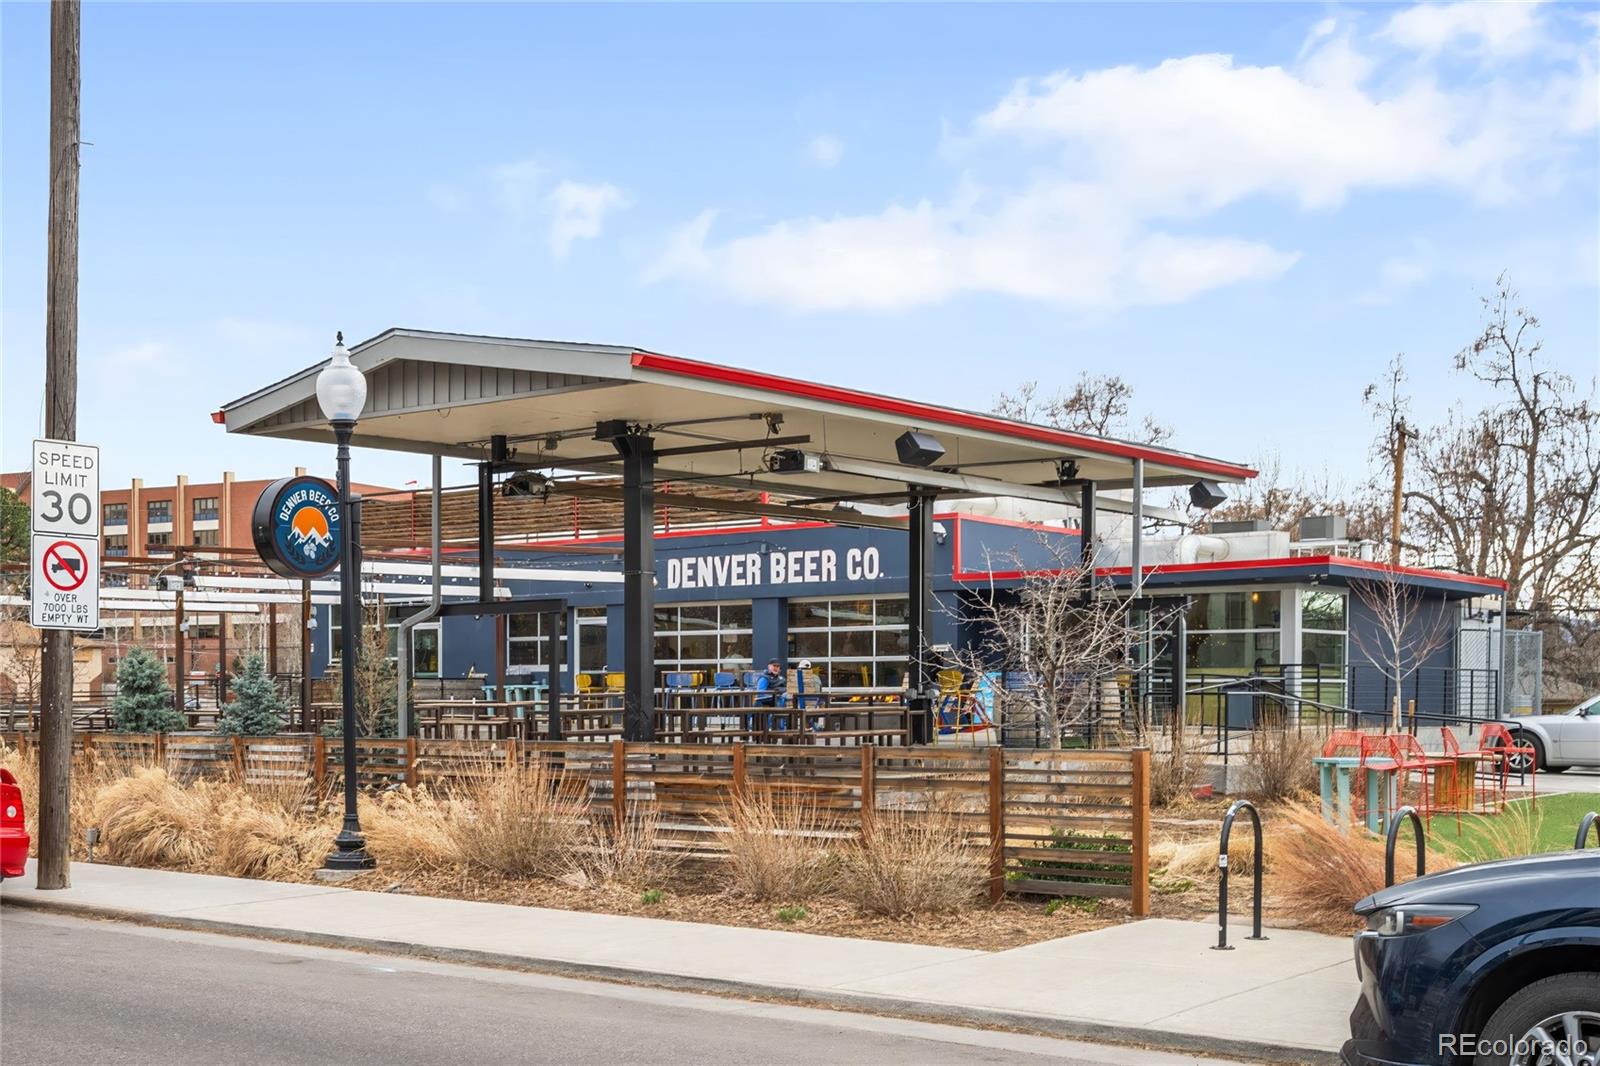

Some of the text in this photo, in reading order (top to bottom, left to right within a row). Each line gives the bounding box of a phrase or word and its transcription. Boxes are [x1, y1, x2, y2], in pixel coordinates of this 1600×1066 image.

[39, 451, 94, 470] SPEED
[45, 471, 88, 488] LIMIT
[40, 490, 92, 525] 30
[279, 489, 308, 521] DENVER
[327, 507, 340, 522] CO
[667, 546, 884, 589] DENVER BEER CO.
[54, 592, 78, 603] OVER
[42, 602, 88, 614] 7000 LBS
[41, 612, 89, 624] EMPTY WT
